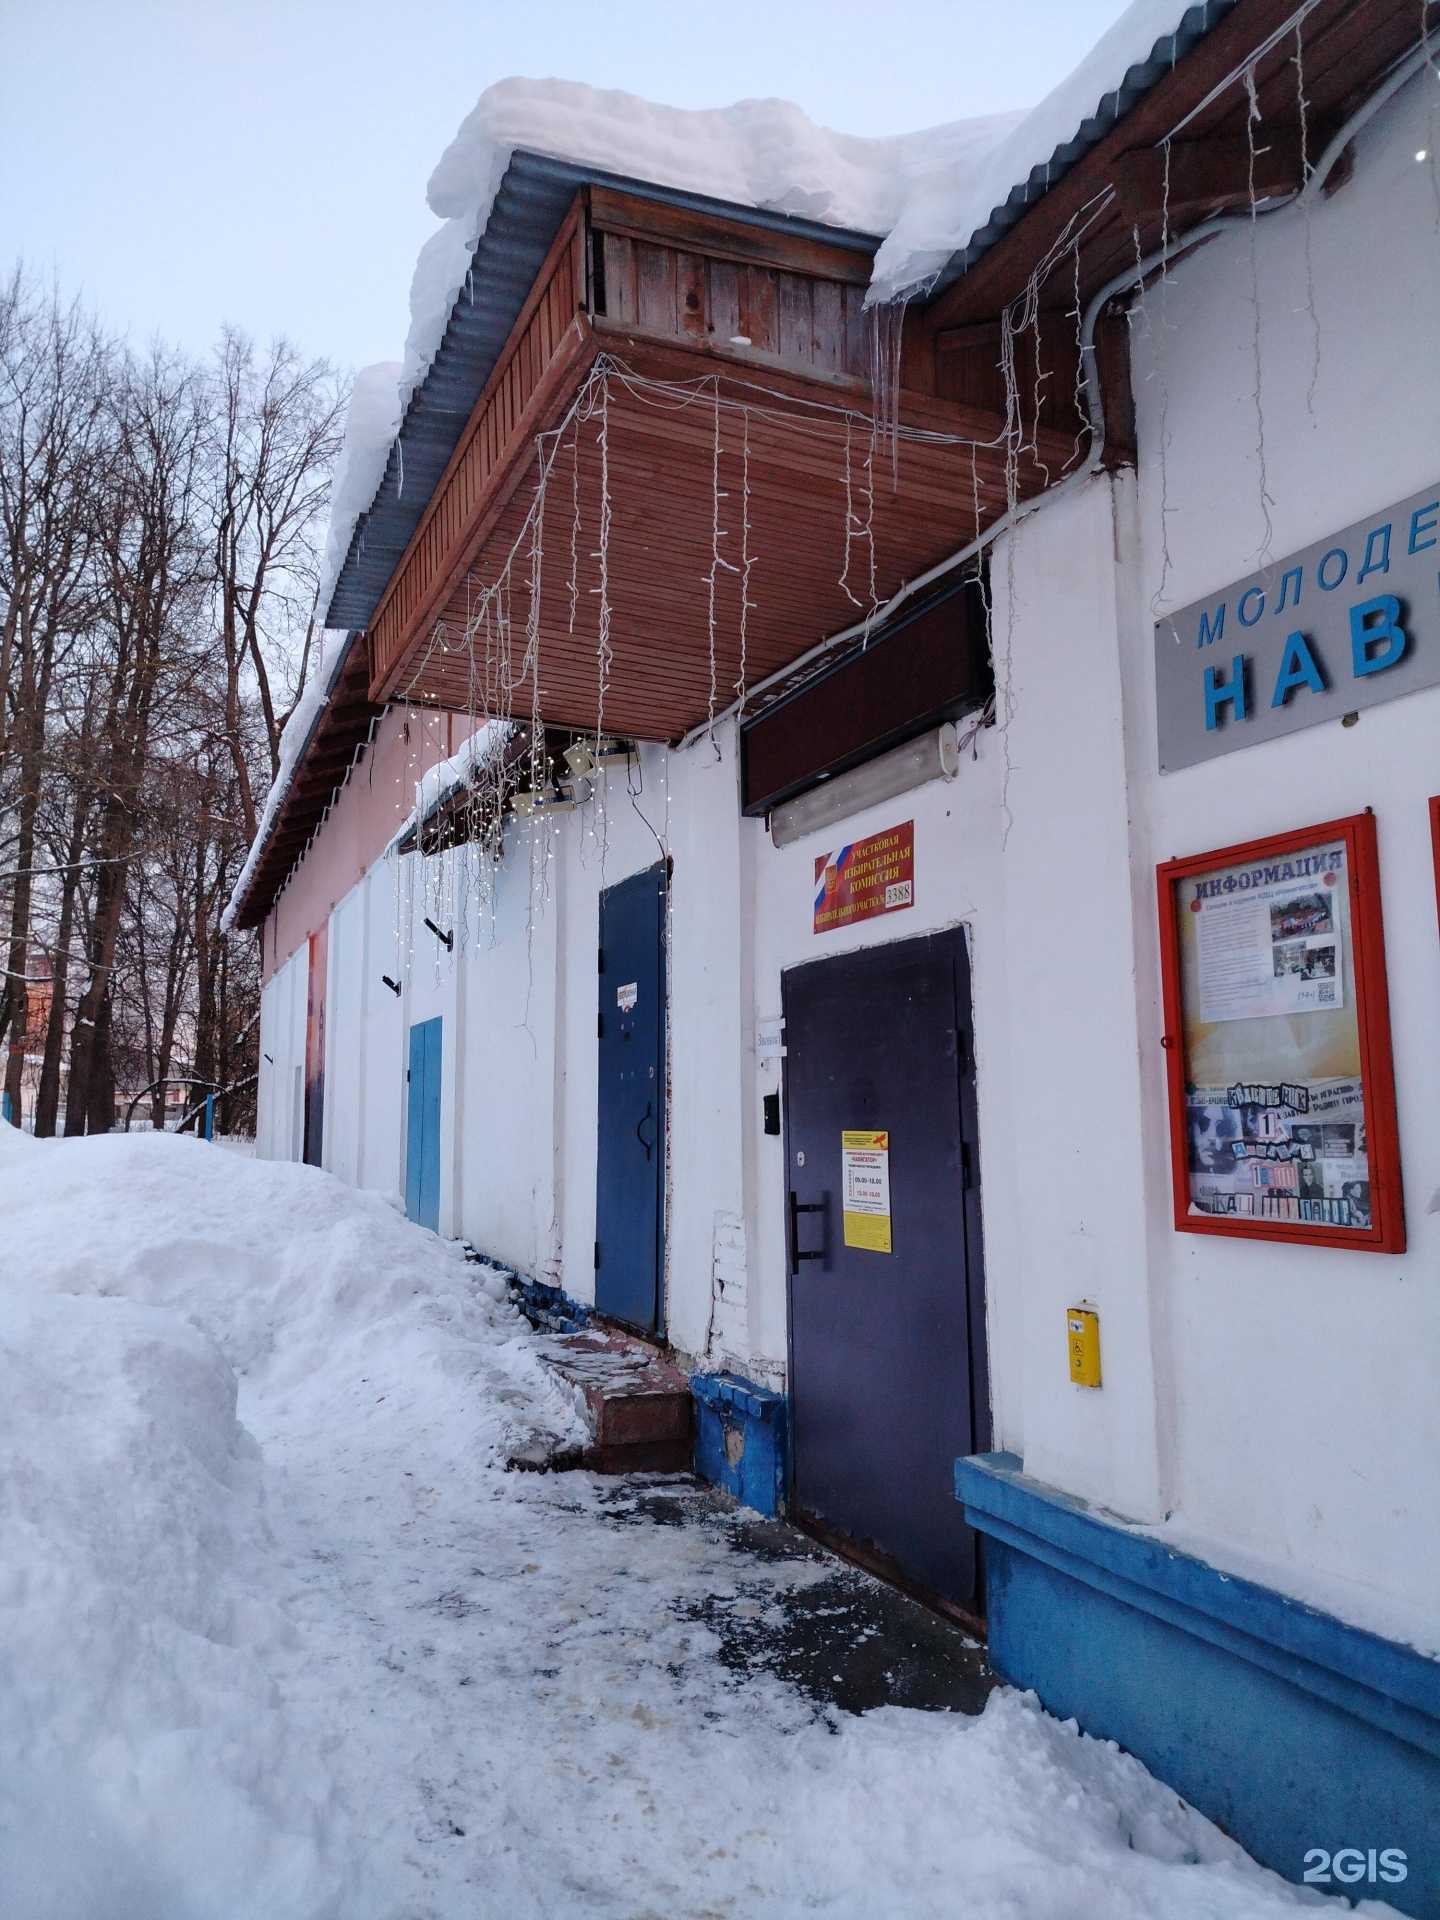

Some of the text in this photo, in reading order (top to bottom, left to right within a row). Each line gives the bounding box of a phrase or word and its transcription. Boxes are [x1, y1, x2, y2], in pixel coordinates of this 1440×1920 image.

[1198, 501, 1439, 650] МОЛОДЕ
[1202, 571, 1440, 731] НАВ
[844, 847, 912, 880] ИЗБИРАТЕЛЬНАЯ
[851, 834, 899, 861] УЧАСТКОВАЯ
[850, 867, 900, 895] КОМИССИЯ
[1195, 850, 1344, 900] ИНФОРМАЦИЯ
